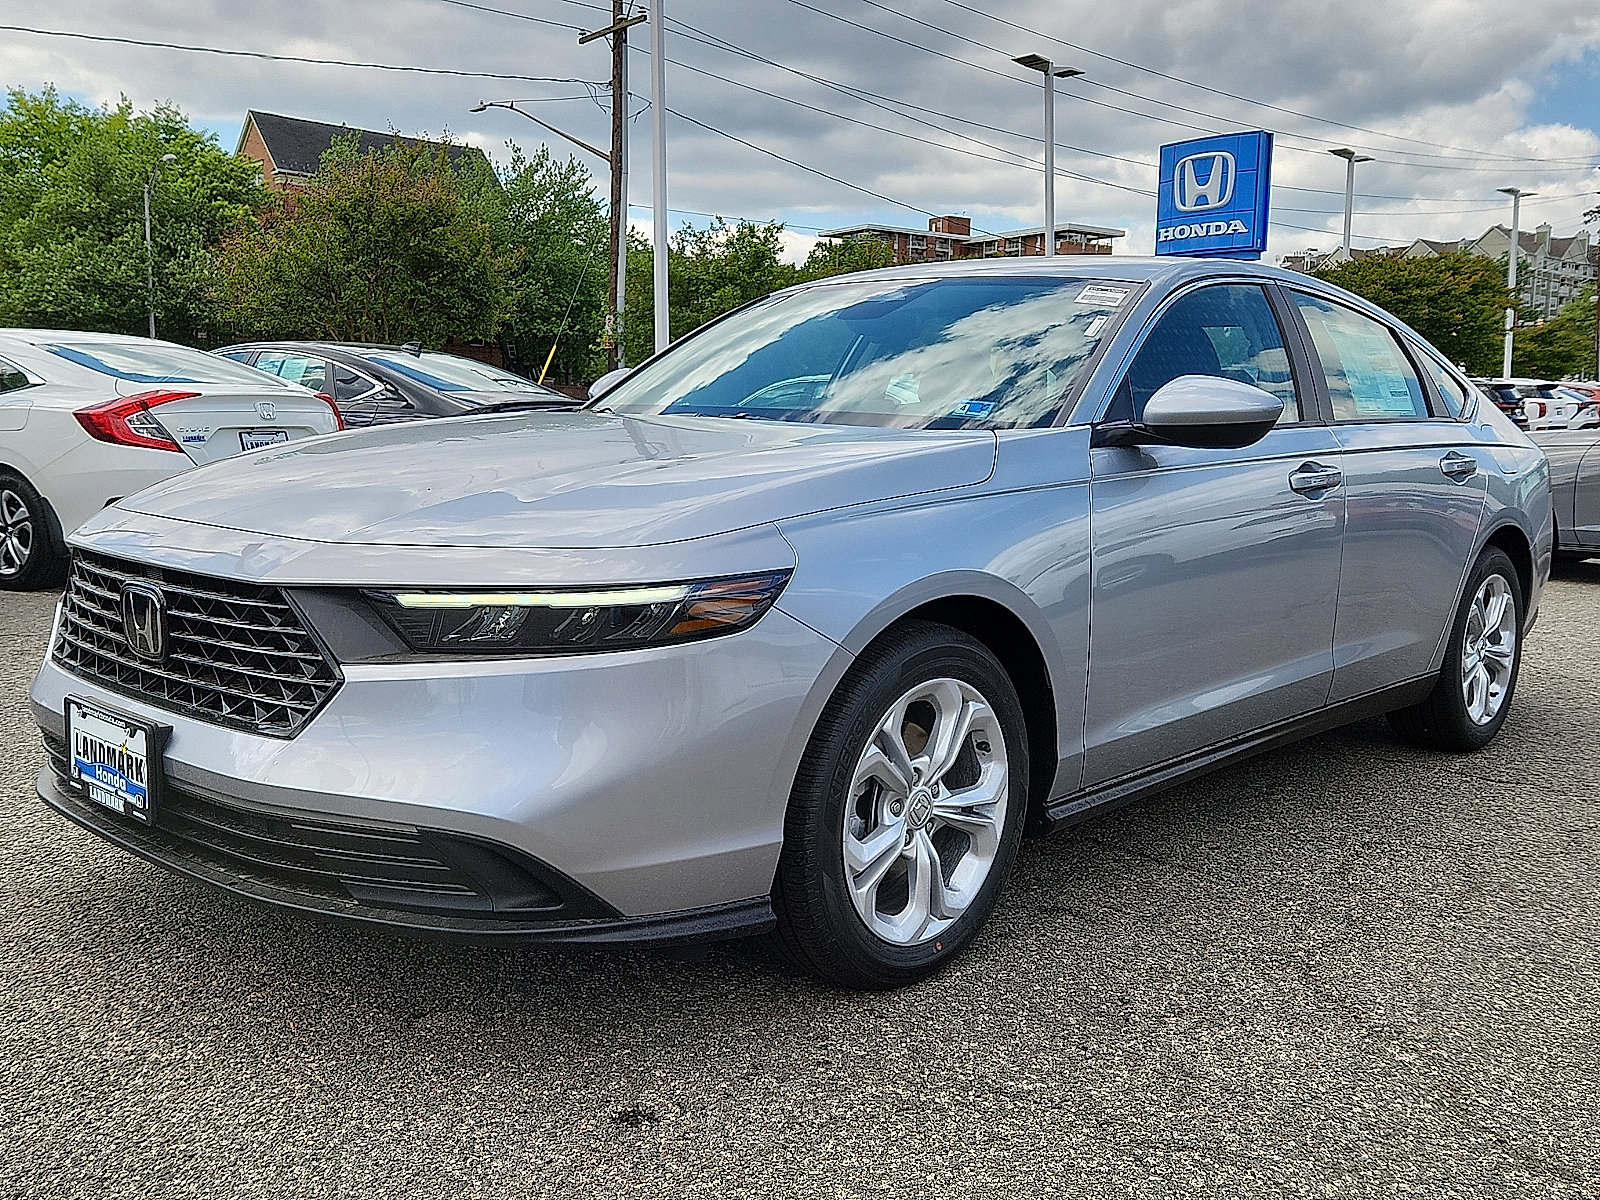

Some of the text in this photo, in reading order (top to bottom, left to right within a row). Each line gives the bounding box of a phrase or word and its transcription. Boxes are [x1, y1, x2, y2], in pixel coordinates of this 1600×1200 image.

[1158, 219, 1249, 242] HONDA
[245, 441, 279, 450] LANDM
[75, 731, 145, 785] LANDMARK
[95, 764, 127, 792] Honda
